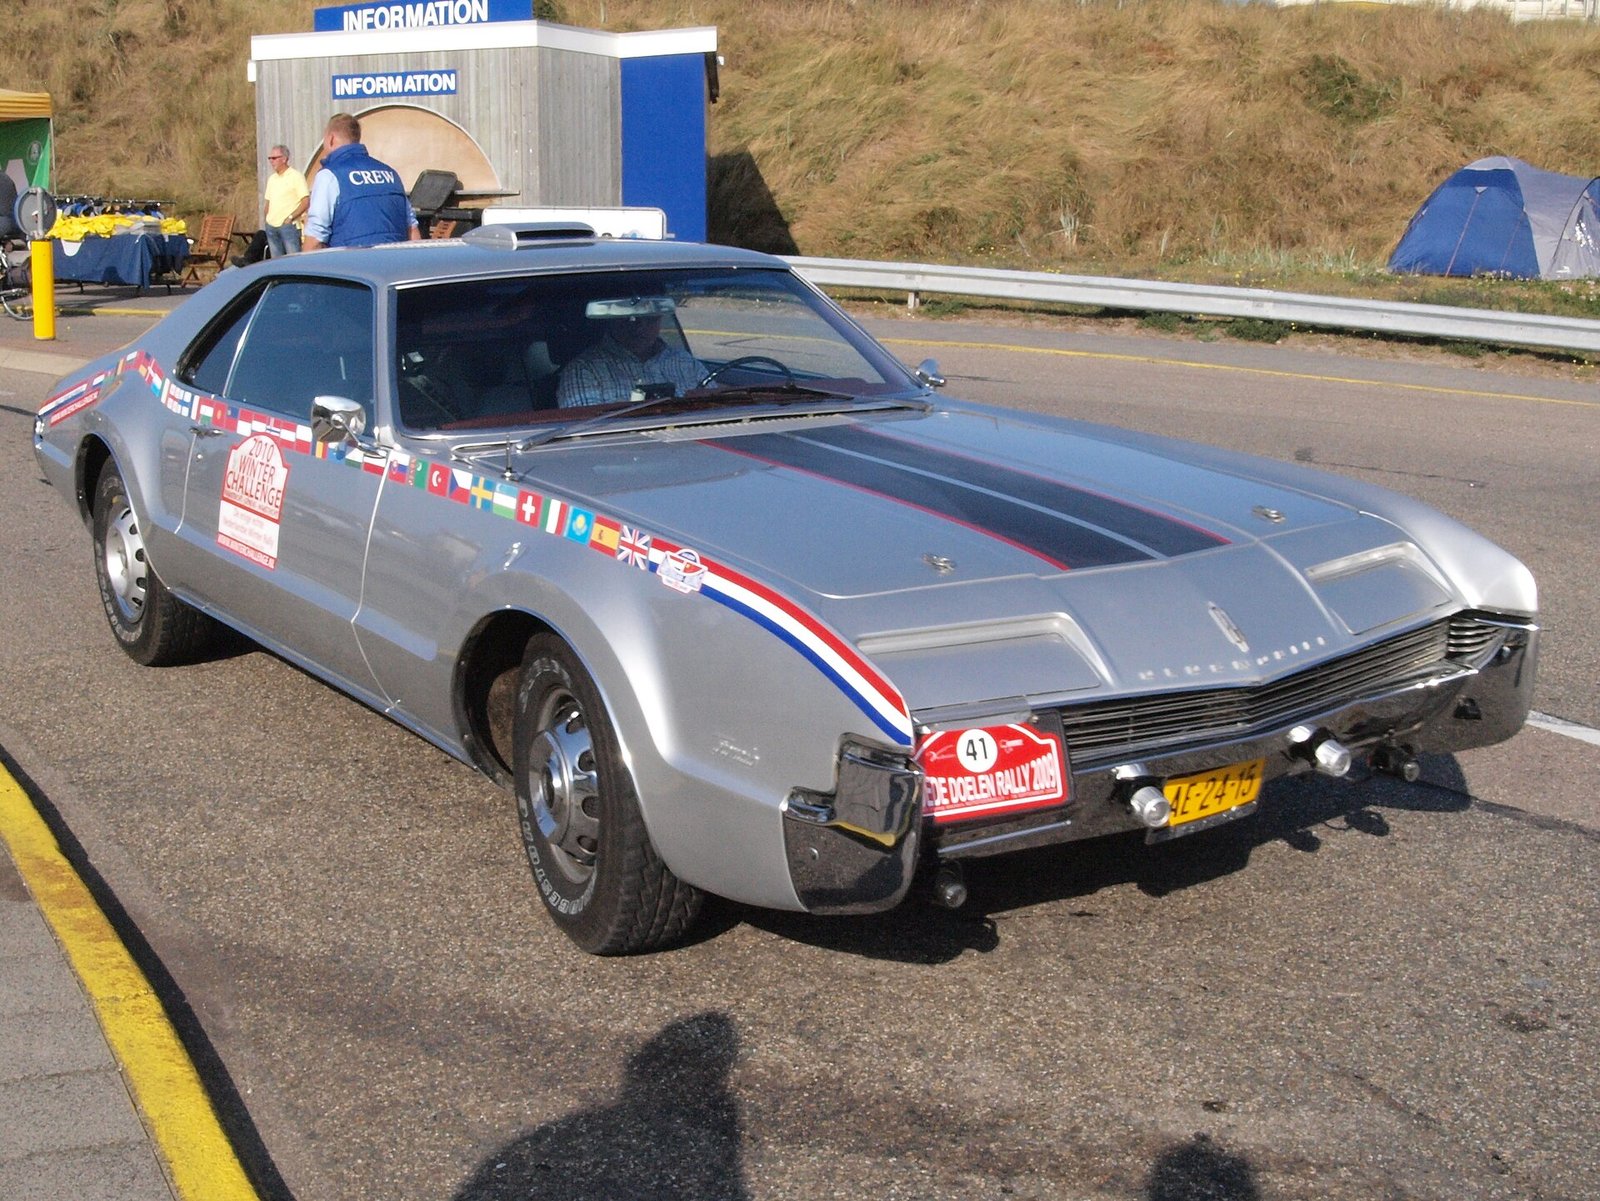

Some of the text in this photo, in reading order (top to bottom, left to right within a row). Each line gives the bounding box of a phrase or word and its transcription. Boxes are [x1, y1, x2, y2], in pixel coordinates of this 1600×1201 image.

[343, 0, 488, 32] INFORMATION
[335, 73, 456, 96] INFORMATION
[349, 170, 394, 186] CREW
[249, 438, 275, 462] 2010
[239, 455, 276, 485] WINTER
[226, 471, 282, 509] CHALLENGE
[966, 738, 988, 761] 41
[947, 773, 996, 804] DOELEN
[995, 762, 1030, 796] RALLY
